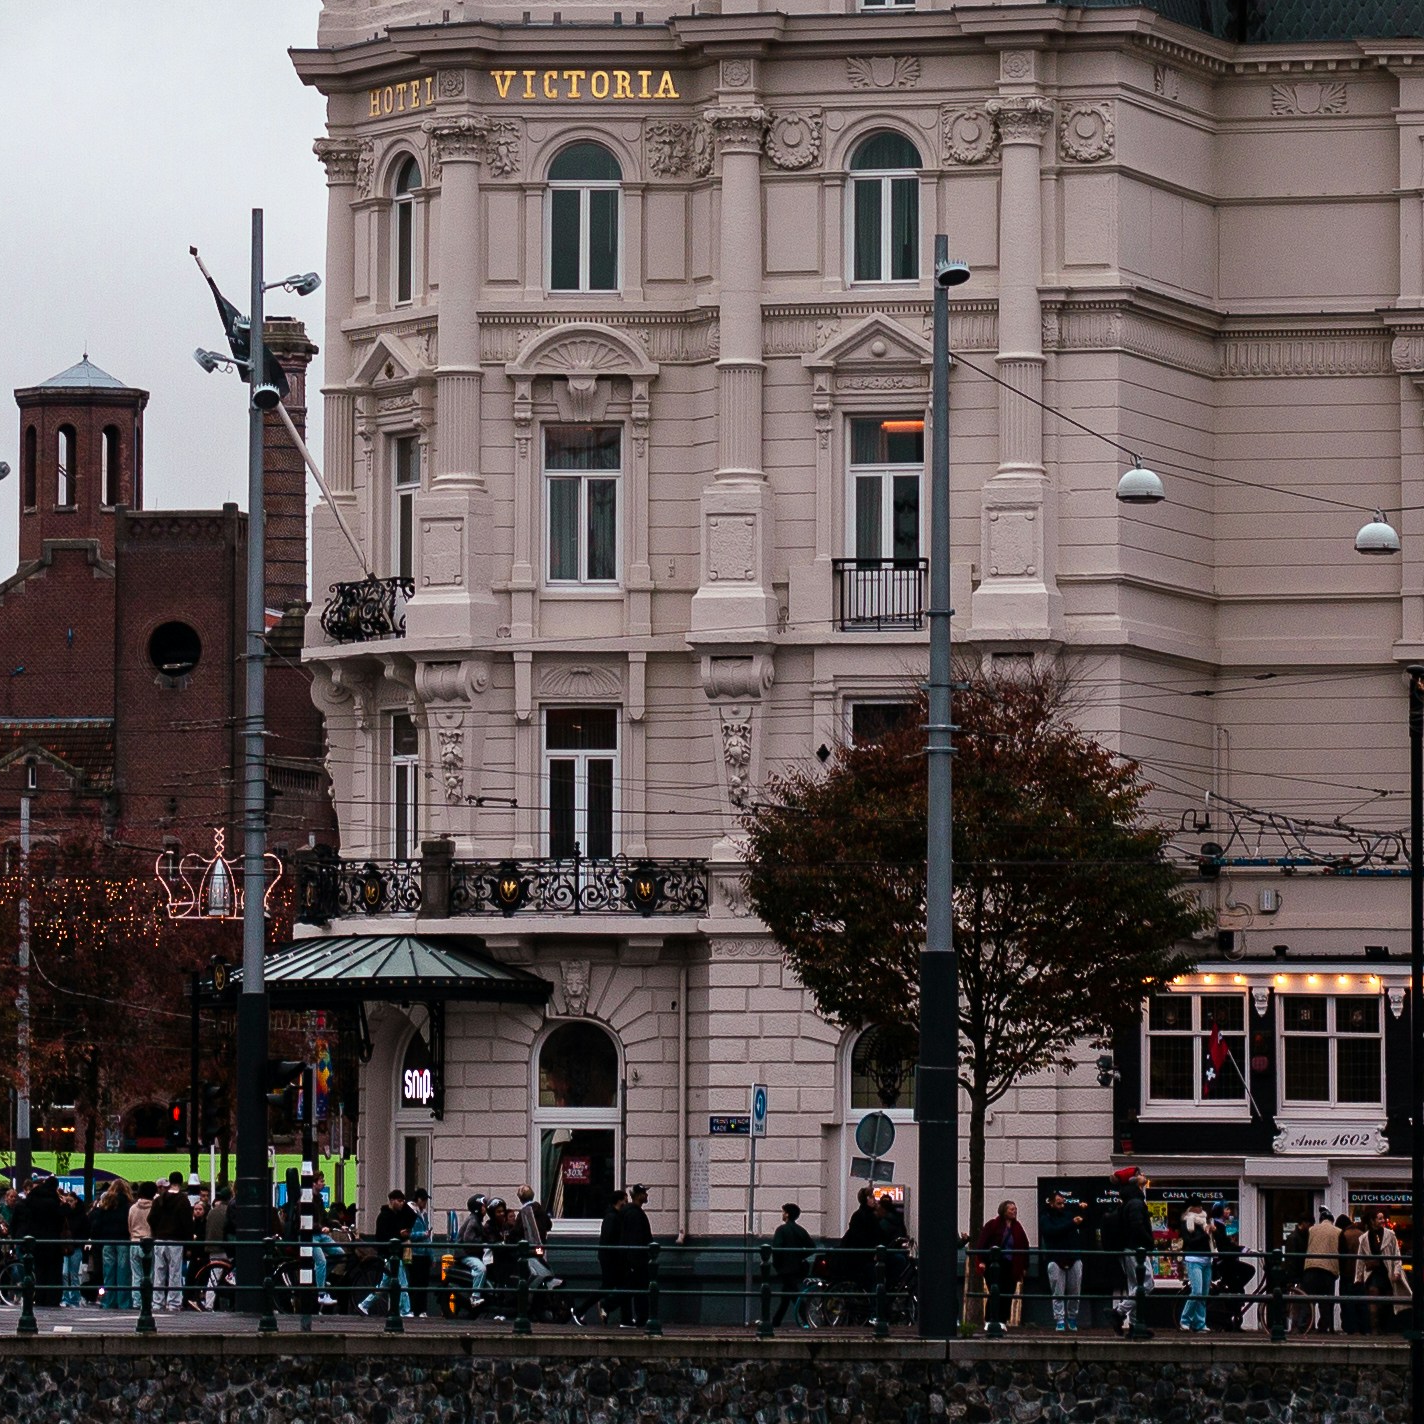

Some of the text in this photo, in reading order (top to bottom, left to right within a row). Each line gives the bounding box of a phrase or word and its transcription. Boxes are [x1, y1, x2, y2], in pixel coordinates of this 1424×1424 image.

[368, 69, 680, 118] HOTEL VICTORIA
[1290, 1133, 1370, 1147] Anno 1602
[1162, 1191, 1225, 1199] CANAL CRUISES
[1351, 1193, 1413, 1202] DUTCH SOUVEN
